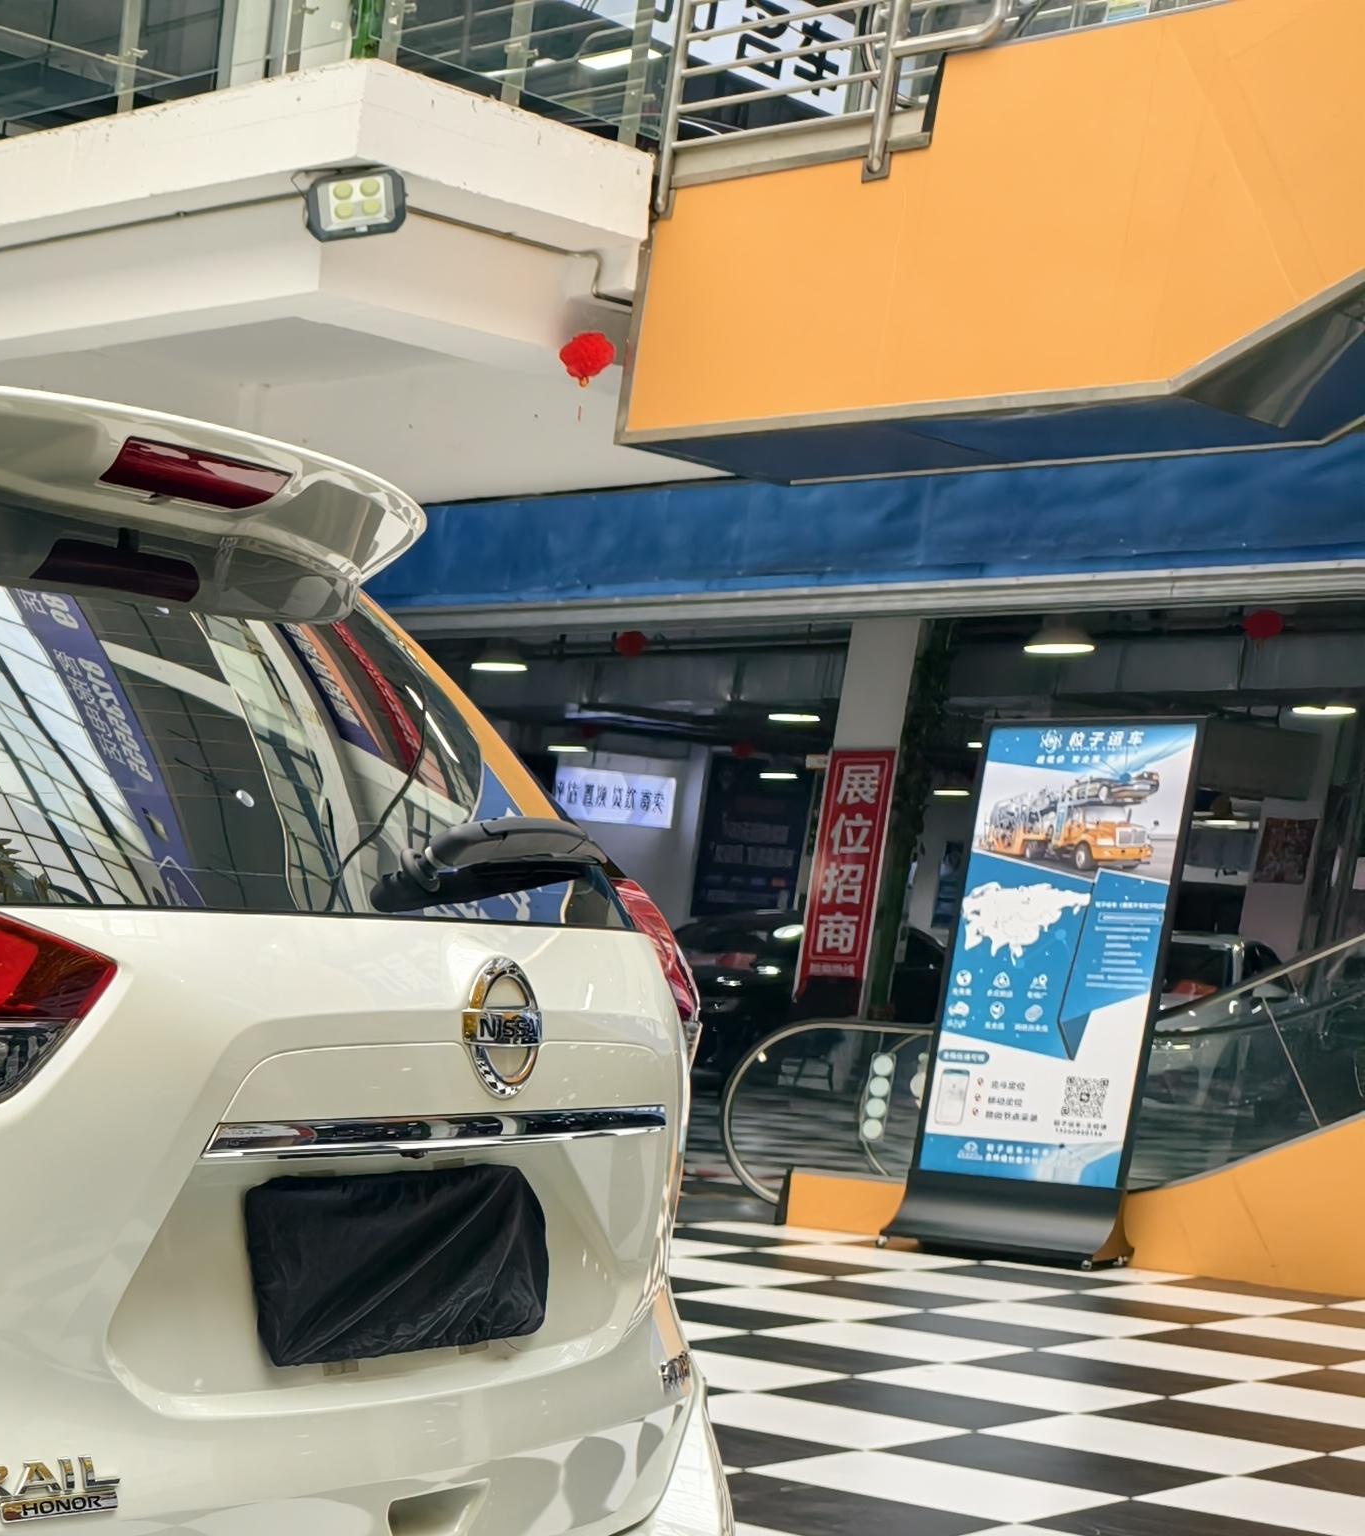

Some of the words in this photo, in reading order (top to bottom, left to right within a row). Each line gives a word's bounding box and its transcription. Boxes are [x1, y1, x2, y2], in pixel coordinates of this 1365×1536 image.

[816, 765, 881, 954] 展位招商
[479, 1016, 542, 1038] NISSAN
[21, 1494, 103, 1517] HONOR
